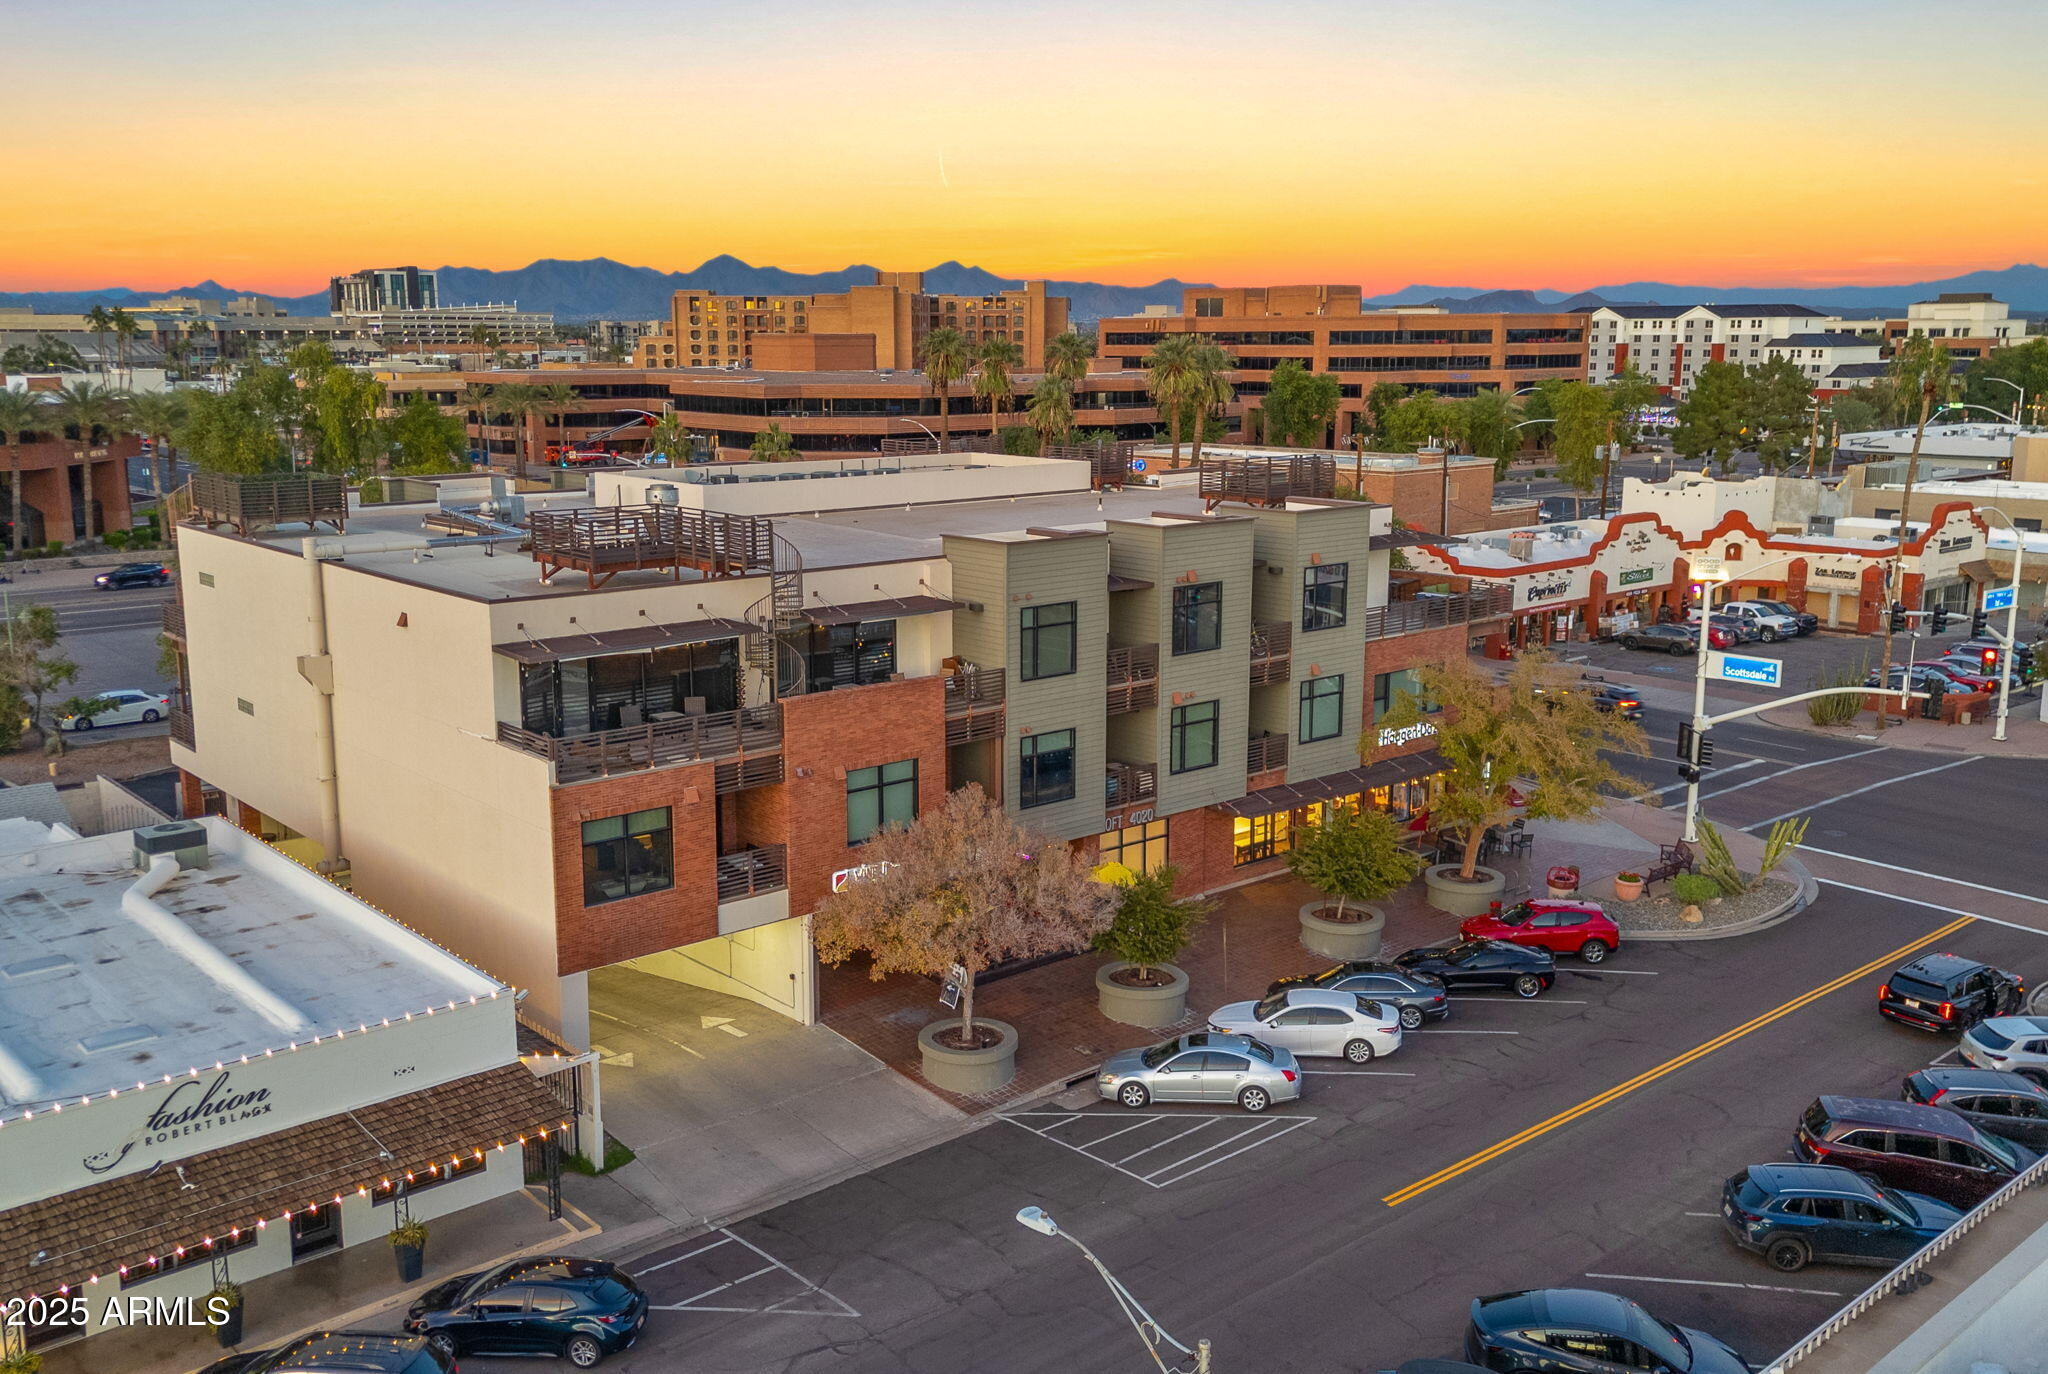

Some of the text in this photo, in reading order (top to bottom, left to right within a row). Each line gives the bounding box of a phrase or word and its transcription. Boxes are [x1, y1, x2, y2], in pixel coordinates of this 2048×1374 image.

[1725, 666, 1767, 680] Scottsdale
[1105, 808, 1154, 832] OFT 4020
[145, 1119, 213, 1147] ROBERT
